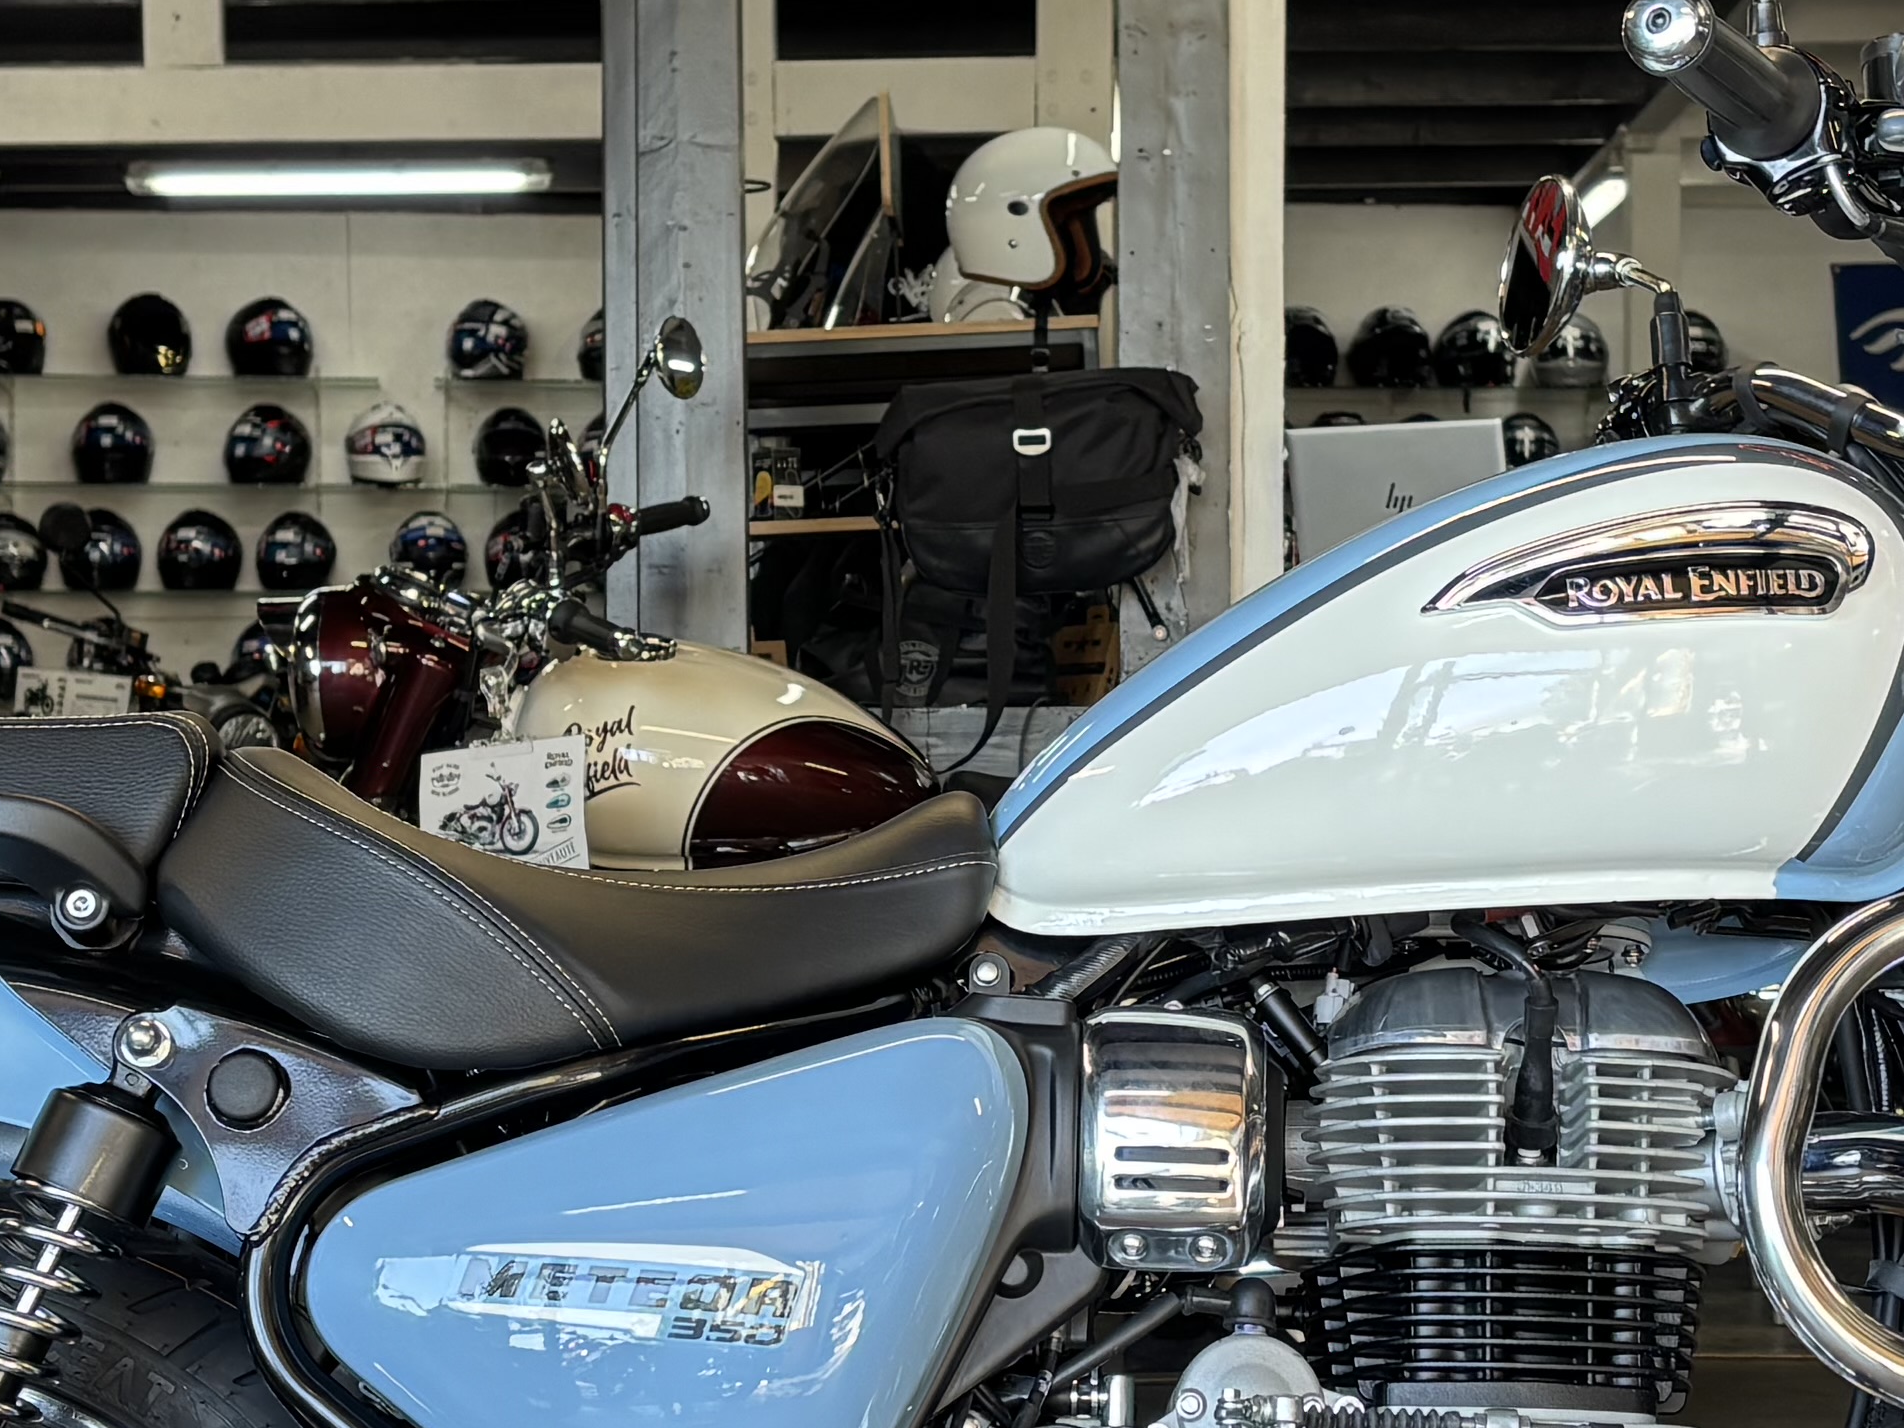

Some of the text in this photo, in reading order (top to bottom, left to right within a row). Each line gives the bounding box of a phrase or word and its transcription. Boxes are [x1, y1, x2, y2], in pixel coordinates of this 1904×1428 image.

[1565, 562, 1826, 609] ROYAL ENFIELD
[456, 1258, 800, 1321] METEOR
[665, 1313, 787, 1347] 350
